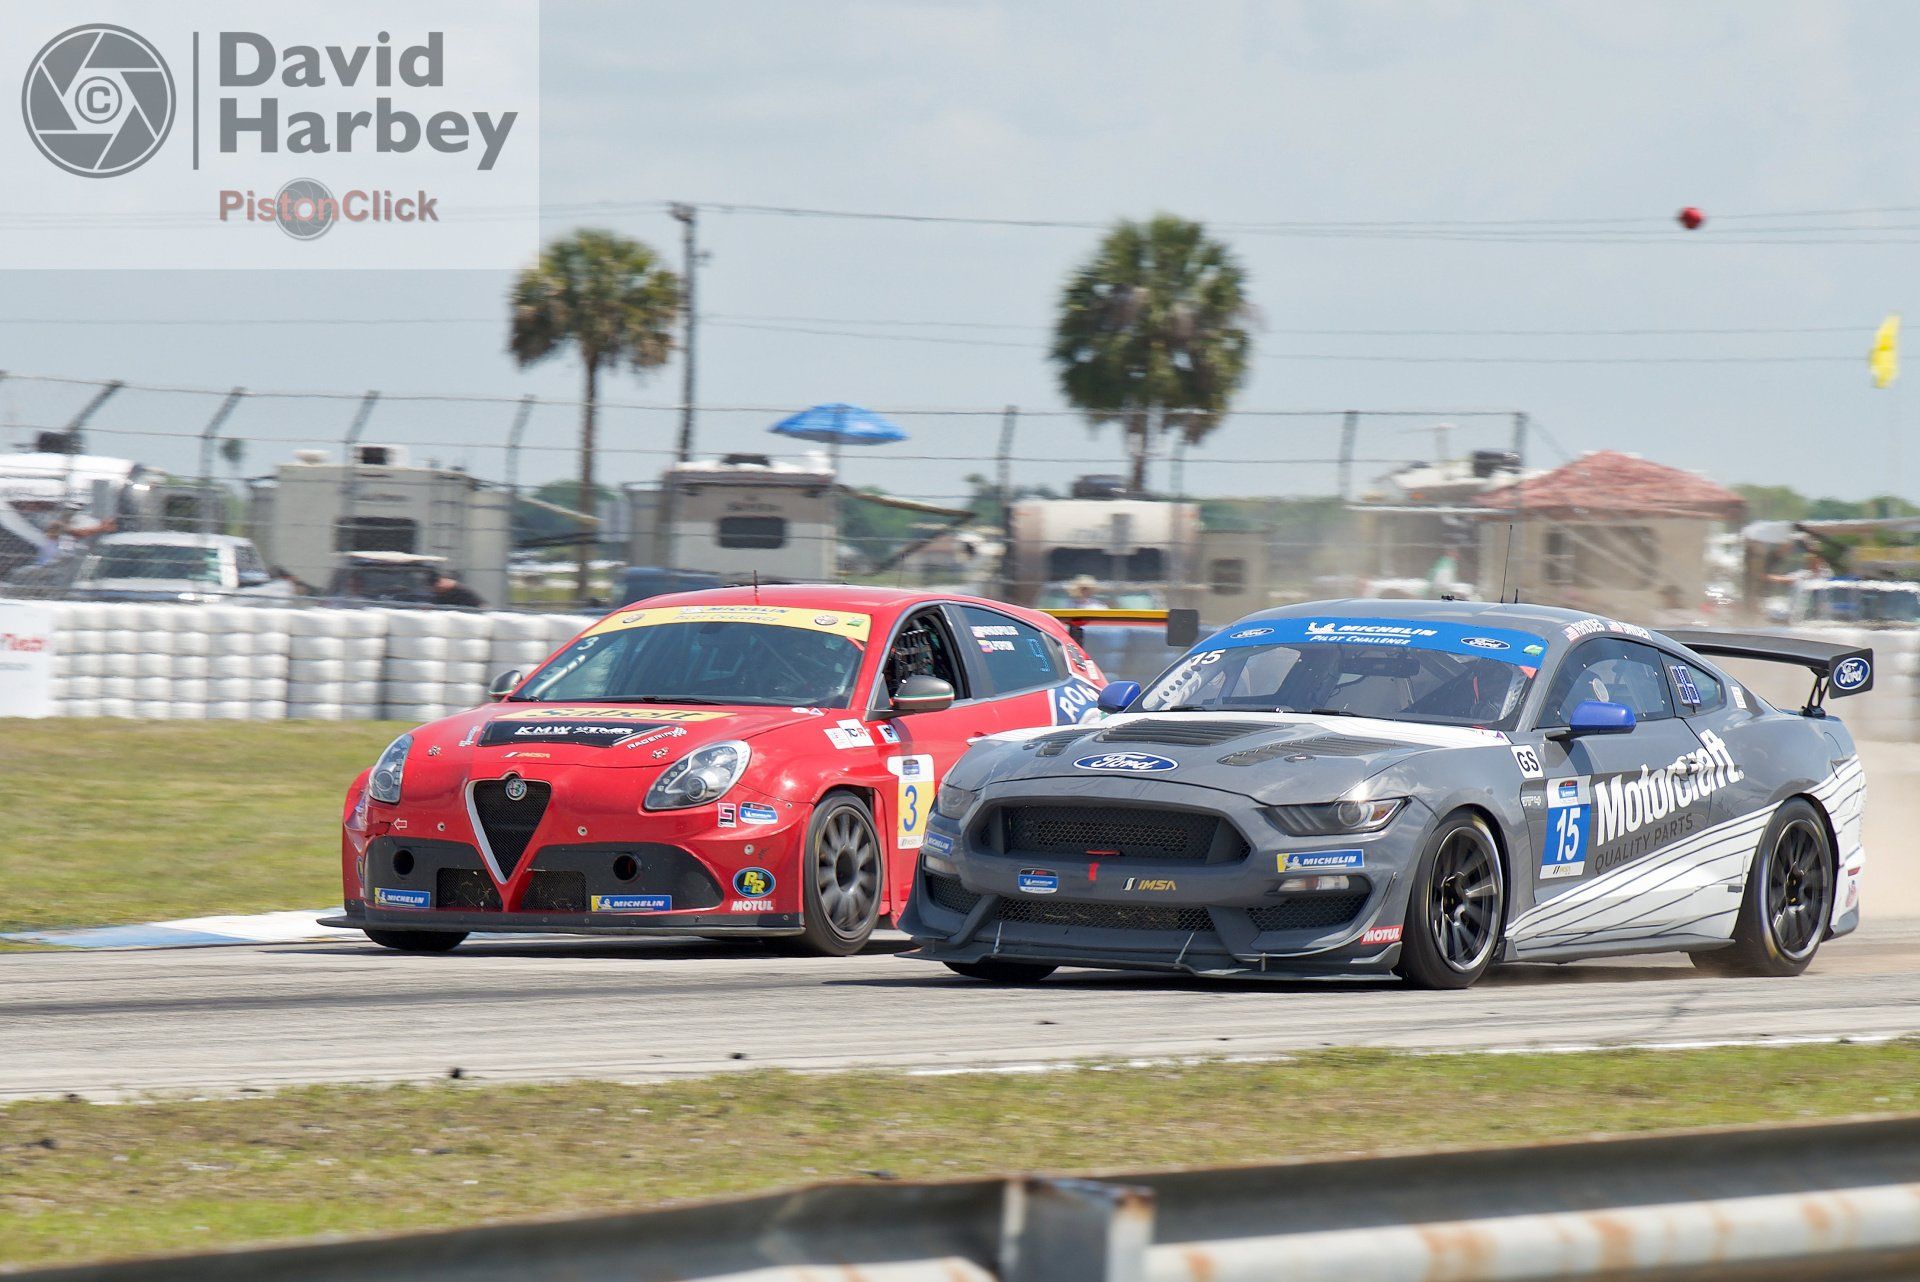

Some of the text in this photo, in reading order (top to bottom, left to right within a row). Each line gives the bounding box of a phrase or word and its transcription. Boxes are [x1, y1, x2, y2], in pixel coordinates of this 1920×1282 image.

[1337, 625, 1438, 637] MICHELIN
[576, 636, 600, 651] 3
[1309, 635, 1411, 646] PILOT CHALLENGE
[1470, 637, 1503, 649] Ford
[1190, 649, 1226, 666] 15
[1840, 660, 1864, 685] Ford
[515, 726, 572, 735] KMW
[1091, 753, 1161, 771] Ford
[1516, 750, 1539, 772] GS
[903, 785, 918, 832] 3
[1556, 807, 1581, 862] 15
[1595, 812, 1693, 874] QUALITY PARTS
[1302, 855, 1357, 866] MICHELIN
[1138, 879, 1177, 891] IMSA
[387, 894, 425, 904] MICHELIN
[612, 899, 665, 908] MICHELIN
[731, 900, 774, 912] MOTUL
[1361, 927, 1400, 943] MOTUL
